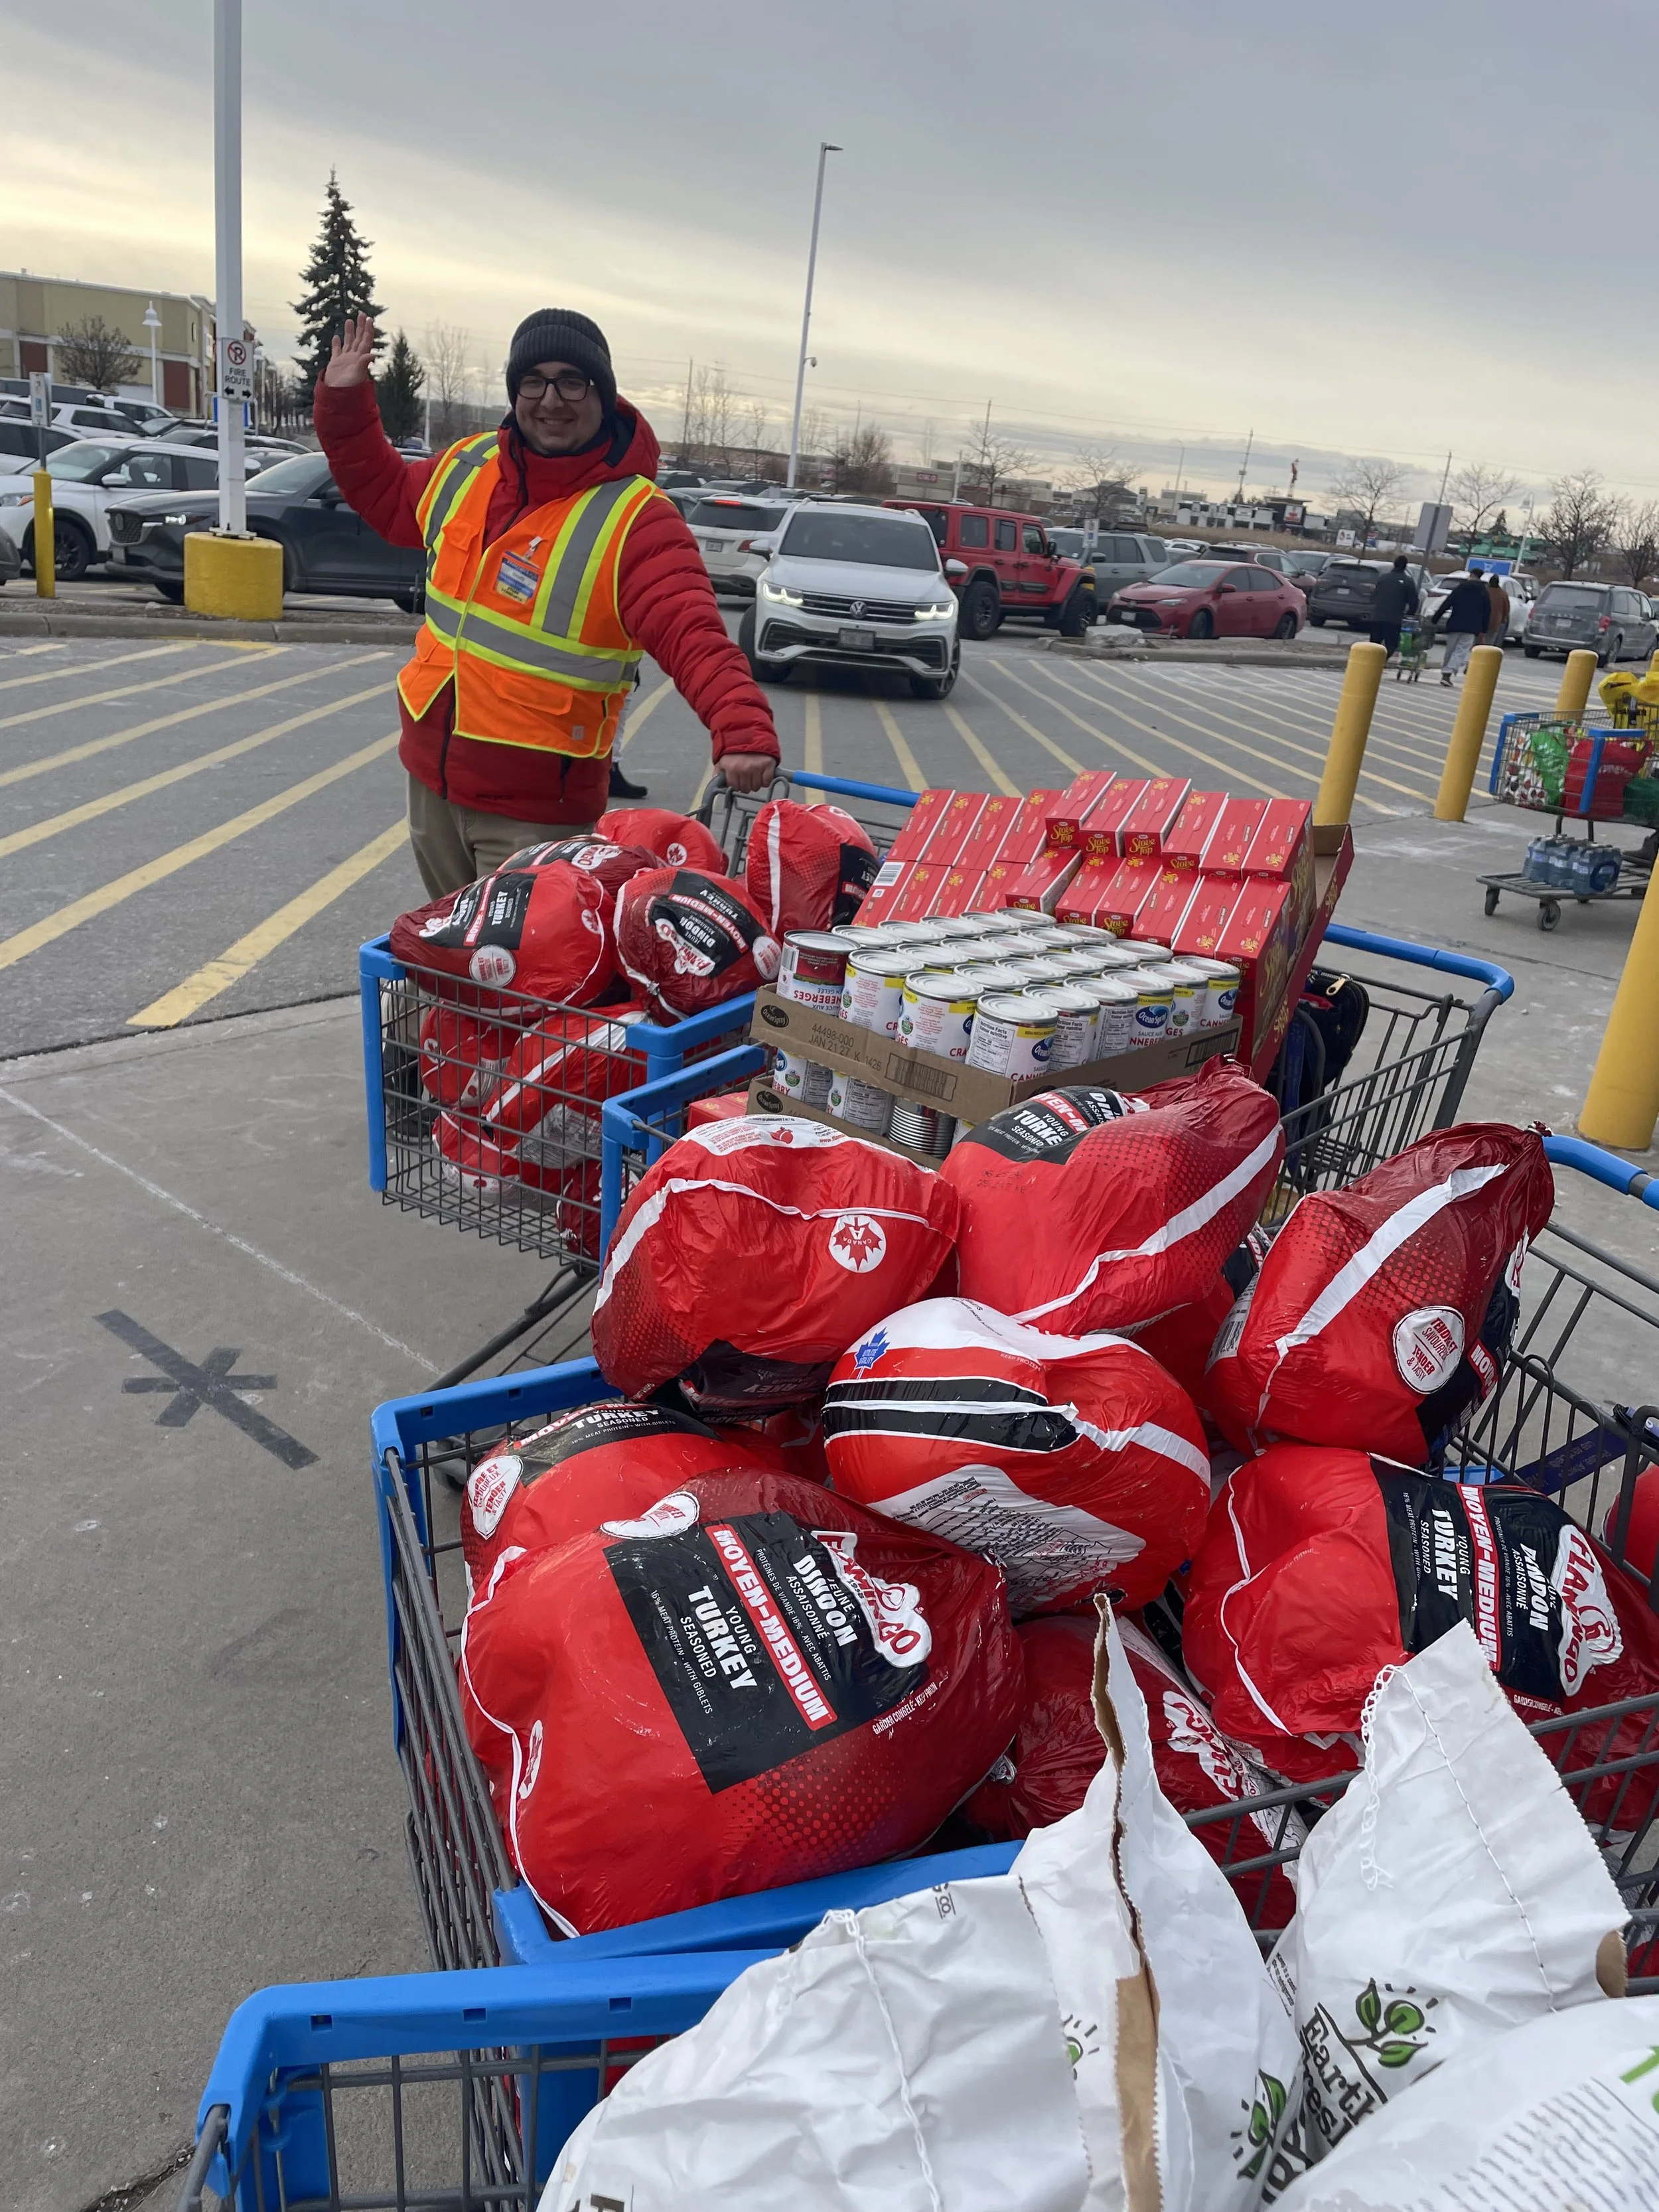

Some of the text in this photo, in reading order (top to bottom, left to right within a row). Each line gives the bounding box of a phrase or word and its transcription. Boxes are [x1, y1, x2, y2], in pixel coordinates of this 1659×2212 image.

[225, 375, 251, 386] ROUTE
[229, 368, 246, 376] FIRE
[1050, 824, 1074, 840] Stove
[1060, 832, 1072, 844] Top
[1086, 836, 1111, 851] Stove
[1129, 836, 1155, 852] Stove
[1094, 845, 1109, 855] Top
[1139, 846, 1153, 855] Top
[491, 891, 508, 926] TURKEY
[699, 889, 739, 920] TURKEY
[672, 895, 747, 950] MOYEN-MEDIUM
[680, 917, 716, 948] DINDON
[1104, 918, 1128, 930] Stove
[1138, 1013, 1168, 1025] Ocean Spray
[812, 1023, 854, 1047] 44498-000
[809, 1035, 881, 1071] JAN 21 27 K 1426
[1035, 1045, 1049, 1058] Ocean
[1011, 1125, 1044, 1147] SEASONED
[1013, 1110, 1062, 1145] TURKE
[1043, 1113, 1068, 1137] YOUNG
[843, 1236, 872, 1245] CANADA
[849, 1227, 865, 1240] A
[1017, 1357, 1041, 1371] FROZEN
[1407, 1358, 1427, 1382] & TASTY
[1412, 1344, 1435, 1376] TENDER
[572, 1410, 660, 1430] TURKEY
[585, 1430, 601, 1439] MEAT
[603, 1424, 630, 1434] PROTEIN
[597, 1416, 649, 1428] SEASONED
[486, 1463, 498, 1474] ET
[485, 1481, 506, 1514] TENDER
[494, 1487, 507, 1509] TASTY
[1409, 1519, 1419, 1544] PROTEIN
[1421, 1520, 1431, 1574] SEASONED
[1431, 1509, 1459, 1601] TURKEY
[1458, 1535, 1471, 1576] YOUNG
[1512, 1548, 1528, 1610] ASSAISONNÉ
[1520, 1543, 1549, 1631] DINDON
[786, 1575, 830, 1640] ASSAISONNÉ
[793, 1554, 858, 1647] DINDON
[827, 1578, 855, 1613] JEUNE
[713, 1530, 830, 1722] MOYEN-MEDIUM
[756, 1548, 831, 1681] PROTÉINES DE VIANDE 16% AVEC ABATTIS
[688, 1585, 758, 1689] TURKEY
[726, 1605, 757, 1654] YOUNG
[651, 1589, 713, 1714] 16% MEAT PROTEIN WITH GIBLETS
[680, 1616, 717, 1678] SEASONED
[872, 1715, 895, 1735] GARDER
[893, 1700, 916, 1722] CONGELÉ
